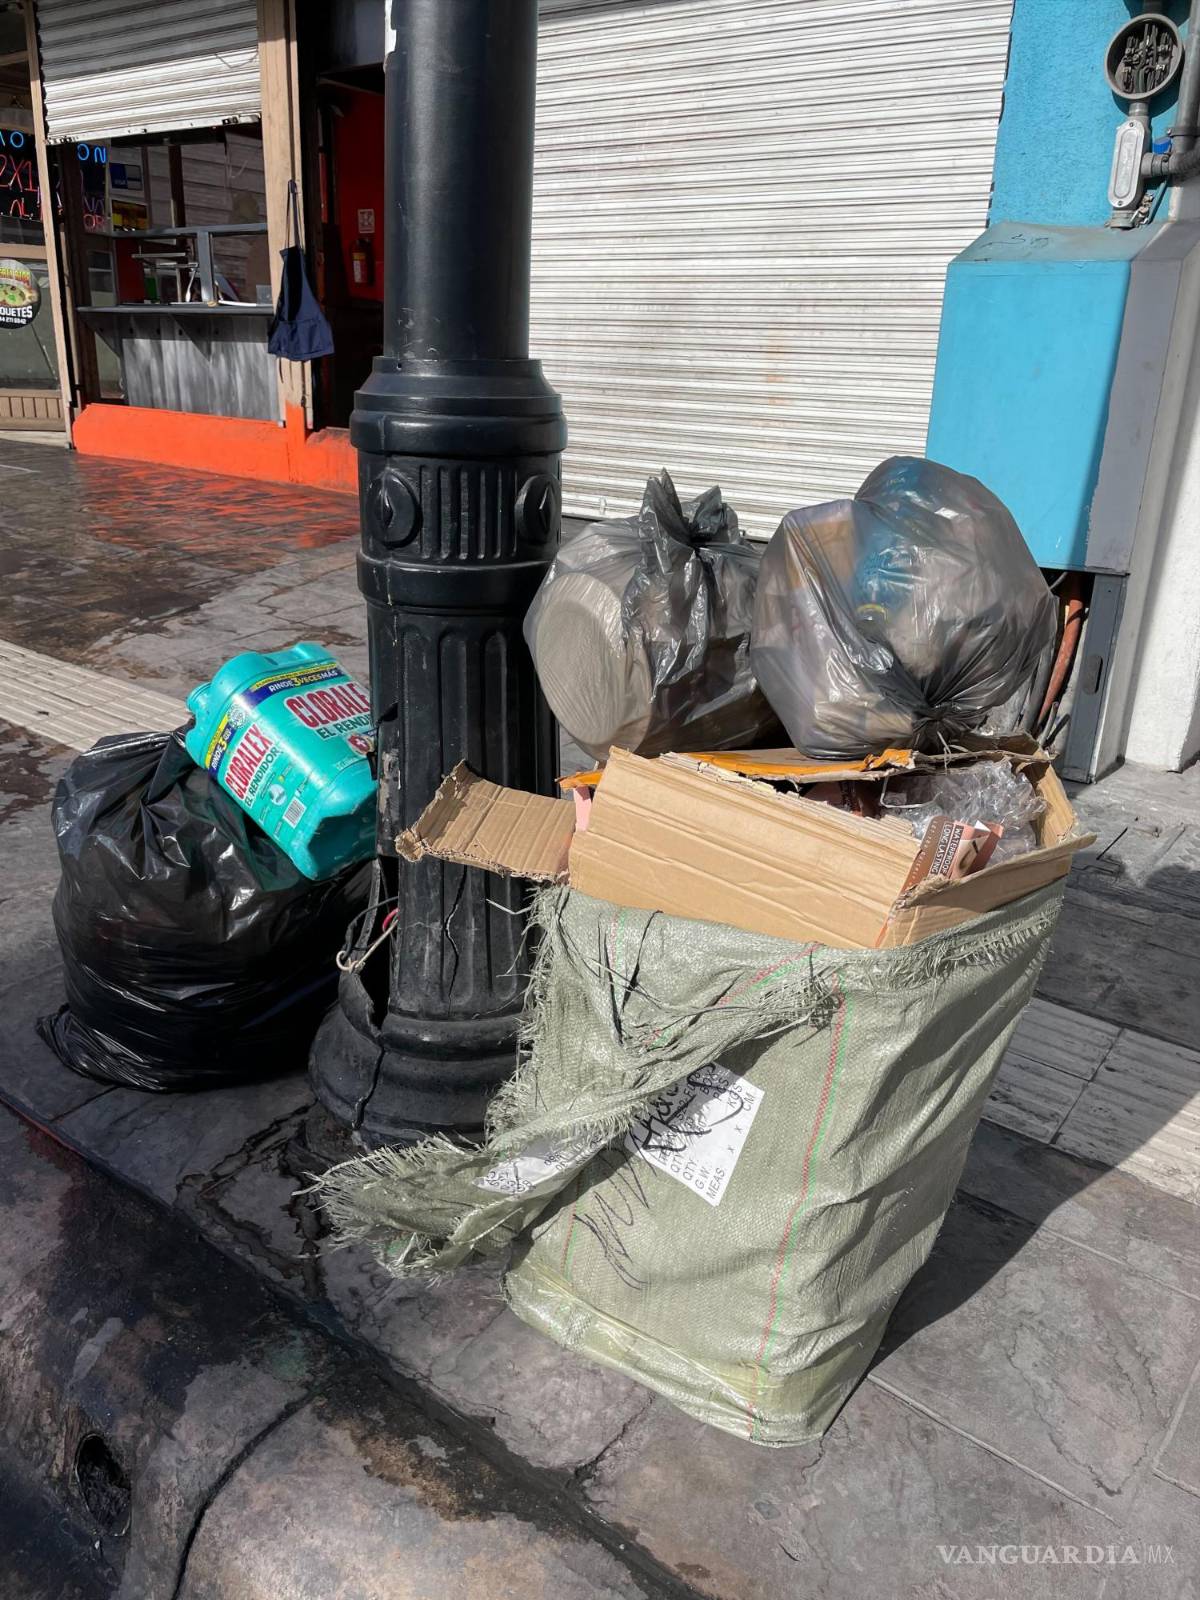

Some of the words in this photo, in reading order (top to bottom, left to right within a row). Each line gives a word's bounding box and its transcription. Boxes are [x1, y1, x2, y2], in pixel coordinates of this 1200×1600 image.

[269, 678, 295, 693] RINDE
[293, 675, 302, 687] 3
[300, 673, 322, 684] VECES
[286, 682, 370, 728] CLORALE
[319, 723, 339, 739] EL
[337, 713, 370, 734] REND
[210, 744, 224, 770] RINDE
[225, 723, 272, 800] CLORALEX
[247, 745, 279, 796] RENDIDOR
[244, 796, 253, 806] EL
[940, 823, 952, 844] LONG
[931, 844, 945, 873] LASTING
[941, 827, 961, 874] WATERPROOF
[741, 1092, 755, 1112] CM
